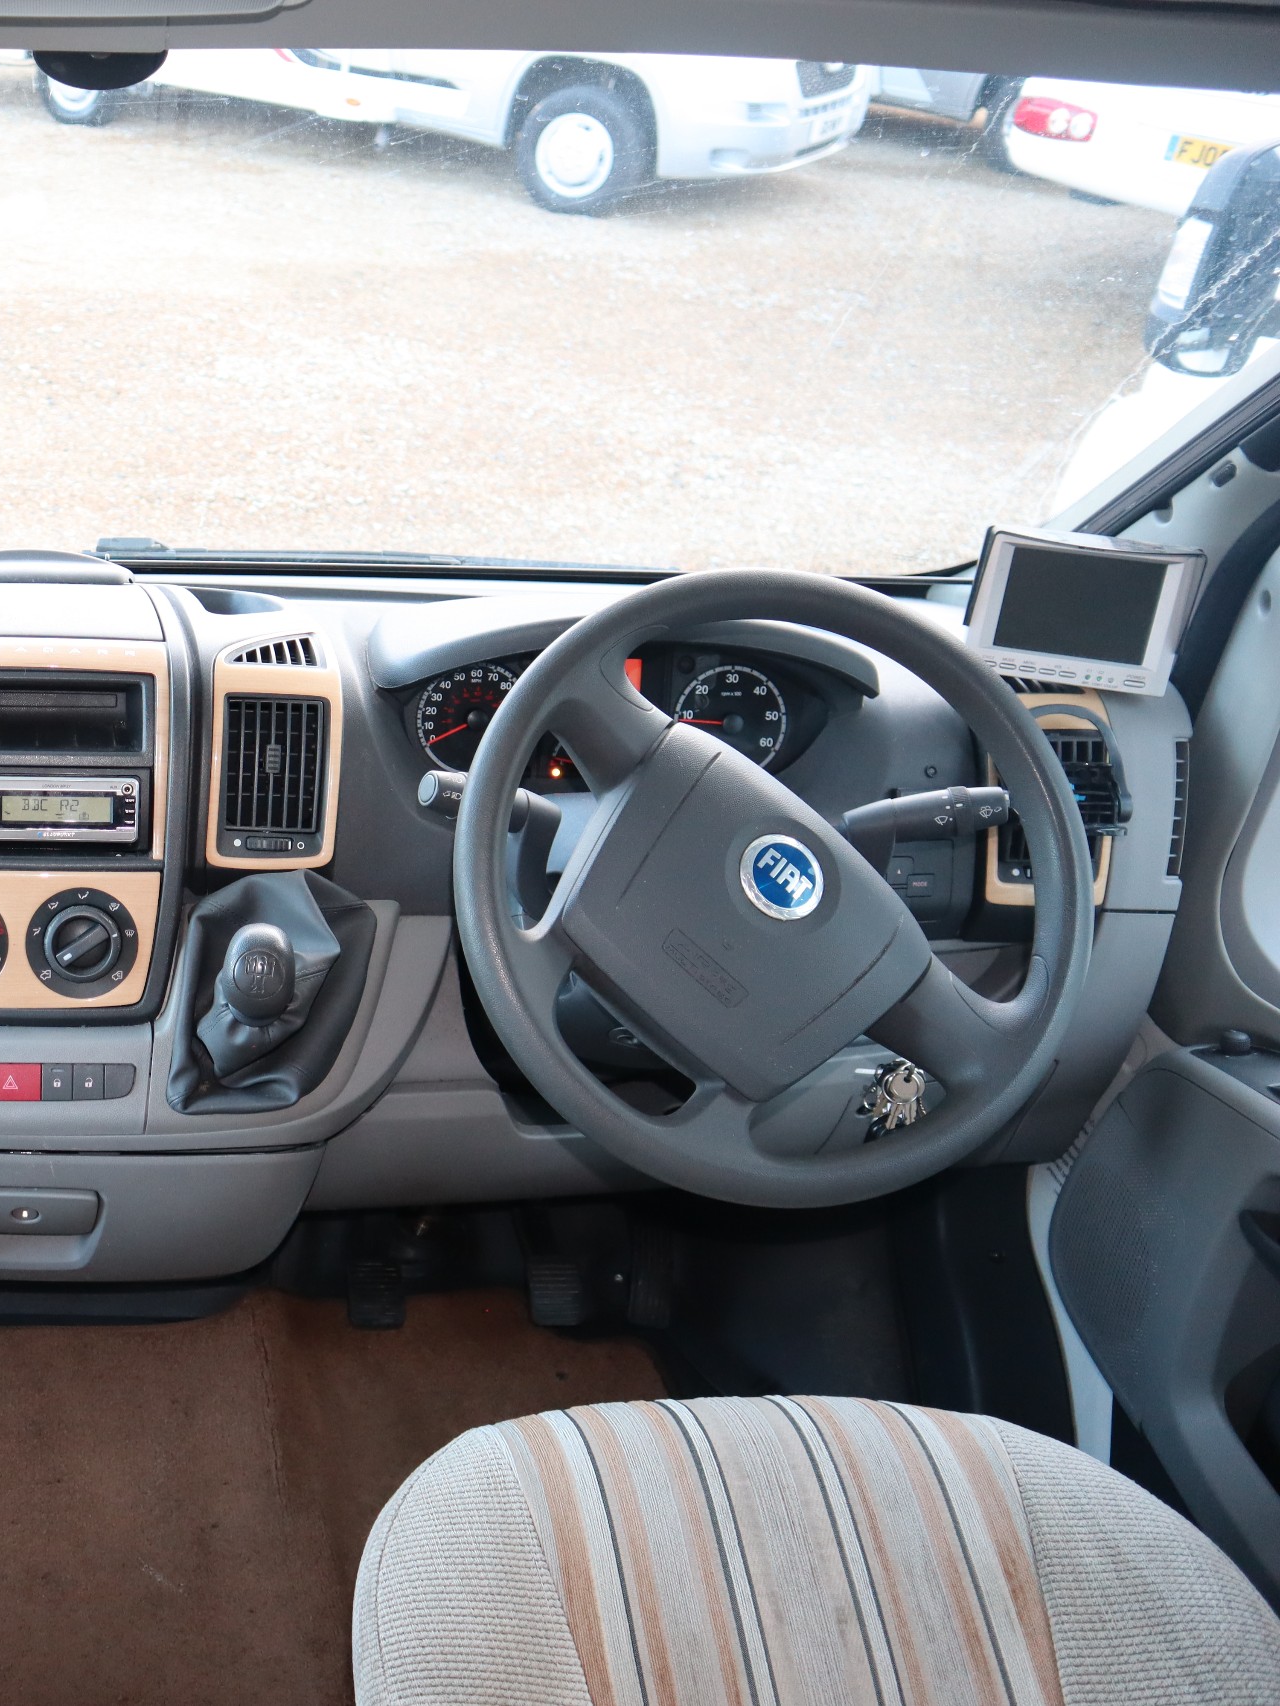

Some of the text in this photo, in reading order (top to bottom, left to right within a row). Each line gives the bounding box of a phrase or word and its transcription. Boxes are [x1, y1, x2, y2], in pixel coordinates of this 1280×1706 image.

[471, 669, 482, 677] 60
[487, 673, 499, 681] 70
[726, 674, 739, 683] 30
[500, 682, 512, 690] 80
[695, 685, 708, 694] 20
[753, 686, 767, 695] 40
[431, 693, 442, 701] 30
[425, 707, 437, 715] 20
[682, 710, 693, 719] 10
[765, 711, 778, 720] 50
[760, 738, 773, 747] 60
[22, 798, 80, 811] BBC R2
[757, 847, 814, 900] FIAT
